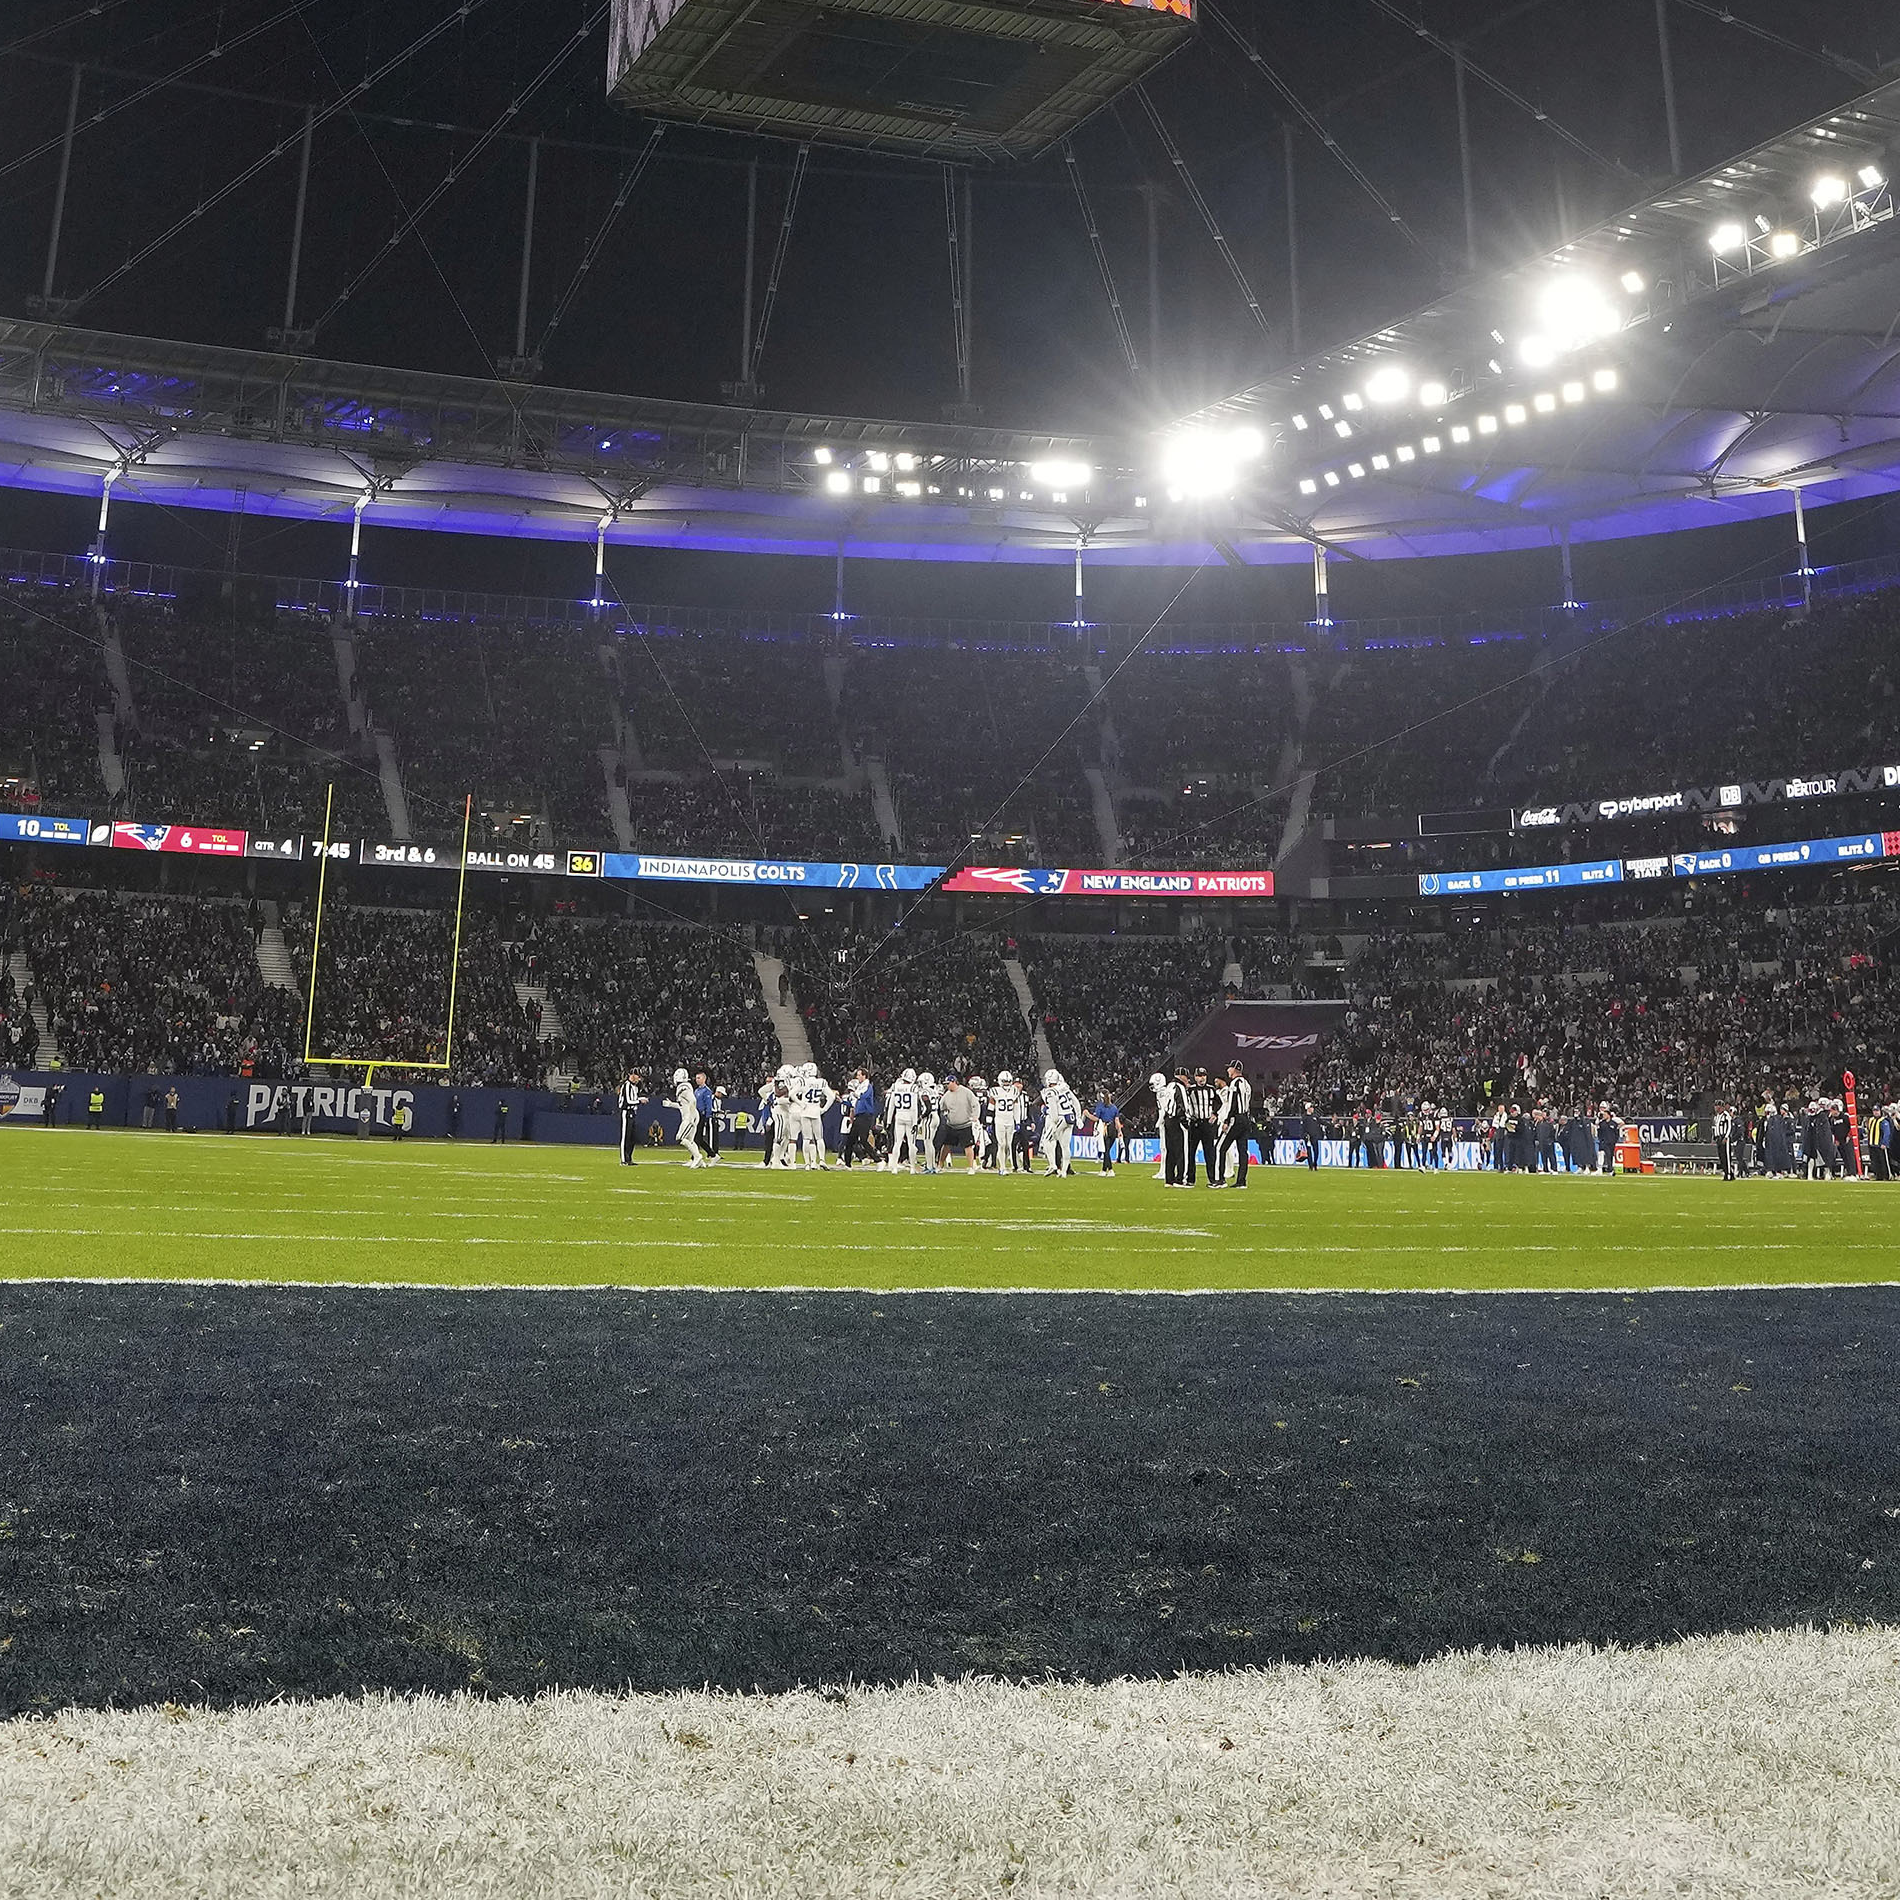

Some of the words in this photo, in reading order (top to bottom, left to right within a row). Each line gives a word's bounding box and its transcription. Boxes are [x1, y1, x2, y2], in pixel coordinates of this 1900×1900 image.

[1786, 779, 1837, 799] DERTOUR
[1618, 792, 1683, 813] cyberport
[17, 819, 40, 836] 10
[53, 822, 70, 832] TOL
[180, 833, 193, 848] 6
[212, 835, 228, 843] TOL
[255, 841, 275, 851] QTR
[280, 839, 293, 855] 4
[1864, 838, 1875, 854] 6
[375, 845, 405, 862] 3rd
[407, 846, 422, 863] &
[424, 847, 436, 864] 6
[467, 851, 503, 867] BALL
[507, 853, 530, 868] ON
[532, 854, 555, 870] 45
[1800, 845, 1811, 860] 9
[571, 856, 593, 873] 36
[643, 860, 751, 879] INDIANAPOLIS
[756, 864, 805, 881] COLTS
[1605, 864, 1614, 879] 4
[1546, 870, 1560, 884] 11
[1634, 867, 1662, 879] STATS
[1083, 874, 1118, 889] NEW
[1120, 875, 1191, 891] ENGLAND
[1199, 877, 1266, 891] PATRIOTS
[1472, 875, 1482, 889] 5
[1231, 1032, 1319, 1049] VISA
[805, 1088, 823, 1104] 45
[894, 1093, 912, 1110] 39
[998, 1098, 1014, 1112] 32
[1423, 1119, 1434, 1132] 10
[1074, 1135, 1098, 1158] DKB
